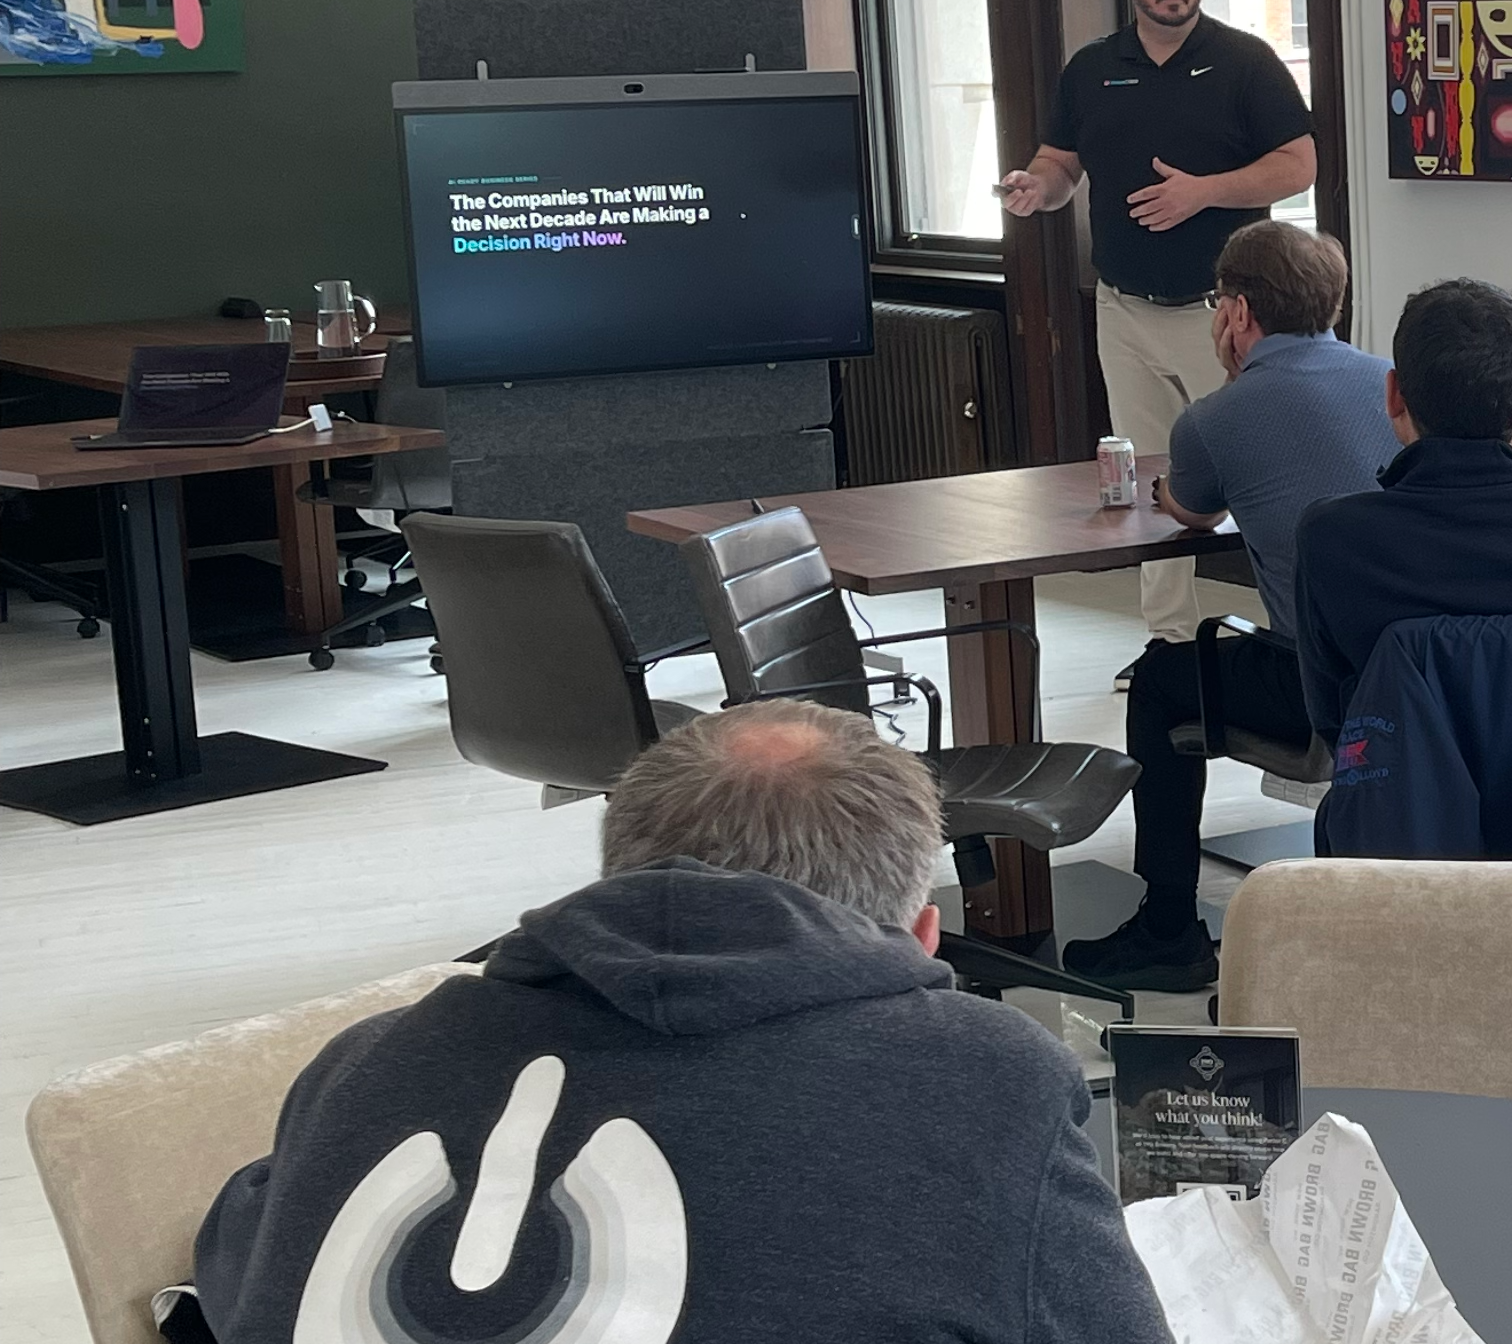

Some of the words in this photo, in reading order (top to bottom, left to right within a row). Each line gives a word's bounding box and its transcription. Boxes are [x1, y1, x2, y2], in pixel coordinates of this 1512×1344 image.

[449, 194, 487, 211] The
[488, 188, 589, 211] Companies
[590, 187, 632, 204] That
[632, 185, 667, 202] Will
[668, 183, 704, 200] Win
[451, 215, 482, 232] the
[484, 213, 528, 231] Next
[529, 210, 597, 229] Decade
[599, 209, 631, 225] Are
[632, 205, 697, 225] Making
[699, 207, 710, 220] a
[453, 234, 532, 254] Decision
[533, 232, 581, 252] Right
[582, 230, 628, 247] Now.
[1166, 1091, 1189, 1106] Let
[1192, 1095, 1209, 1107] us
[1211, 1092, 1251, 1107] know
[1155, 1109, 1190, 1124] what
[1193, 1113, 1219, 1127] you
[1221, 1111, 1264, 1127] think!
